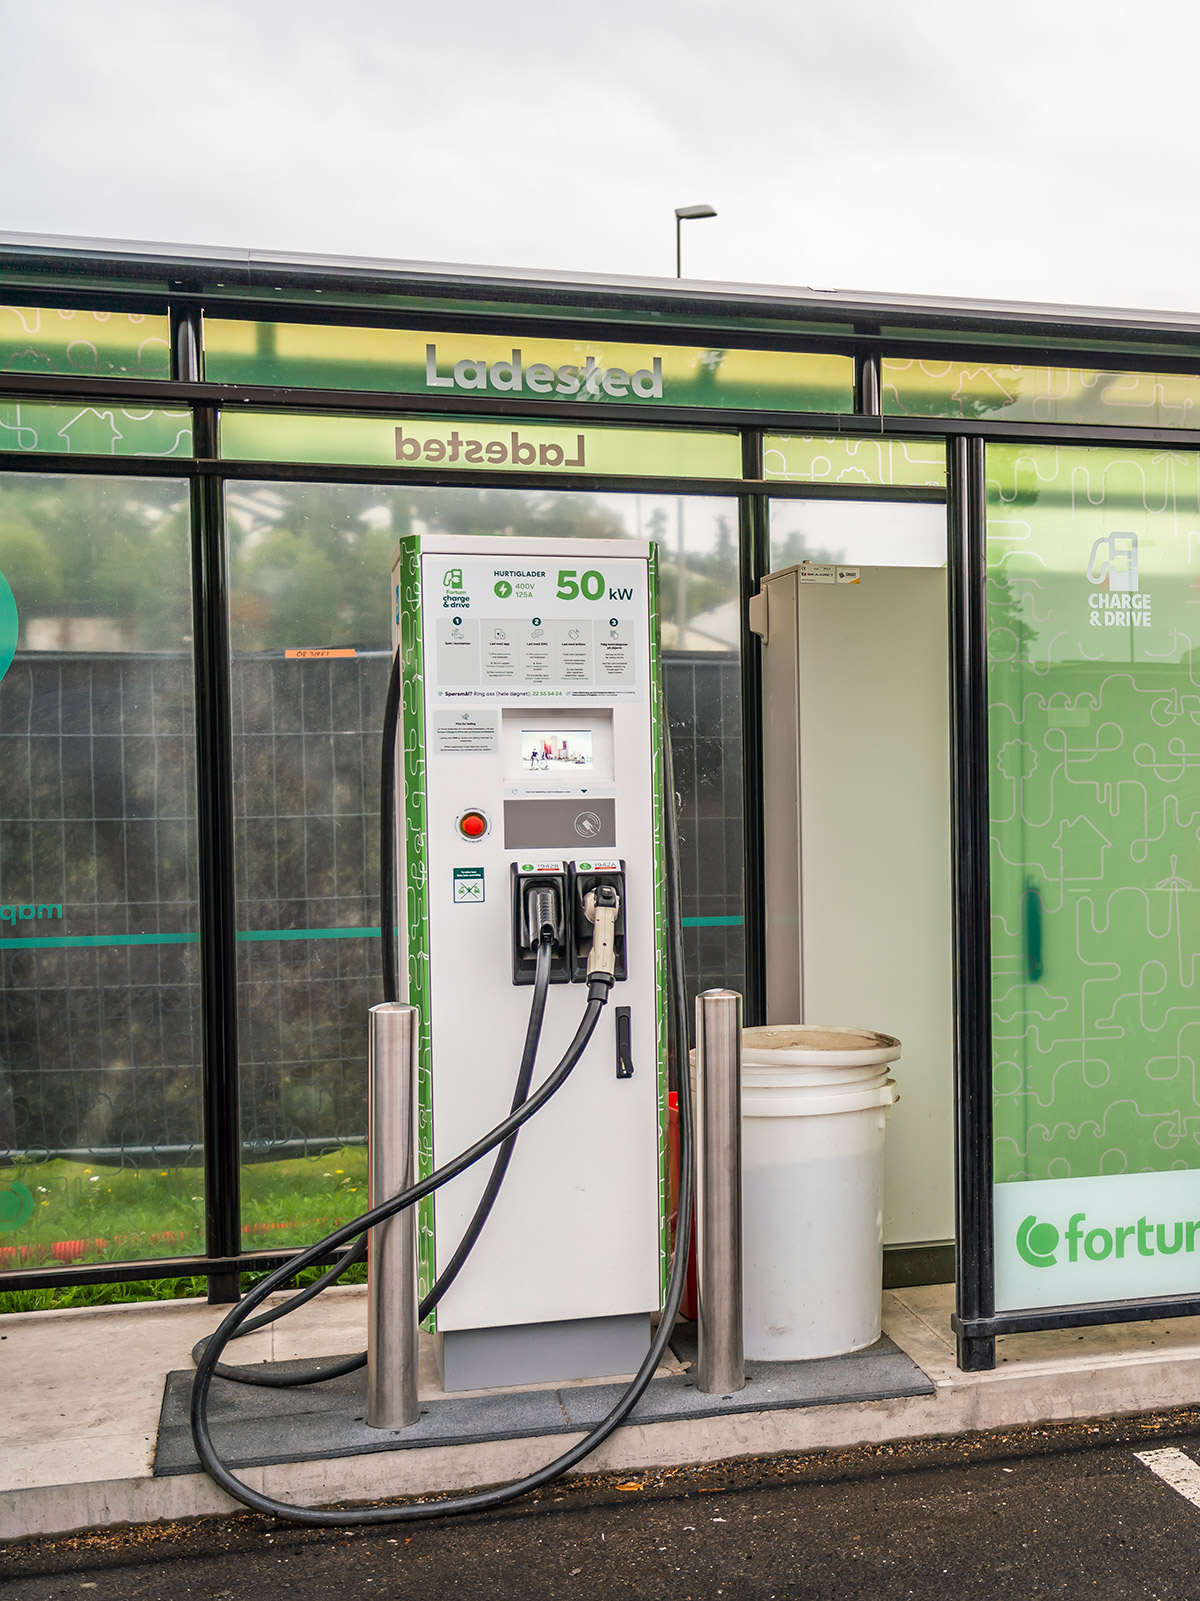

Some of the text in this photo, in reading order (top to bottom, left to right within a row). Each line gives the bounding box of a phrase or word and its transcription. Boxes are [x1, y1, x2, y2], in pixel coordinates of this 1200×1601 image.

[426, 344, 663, 399] Ladested
[556, 570, 633, 601] 50 kW
[443, 595, 470, 603] charge
[1088, 593, 1151, 610] CHARGE
[1089, 611, 1151, 627] & DRIVE
